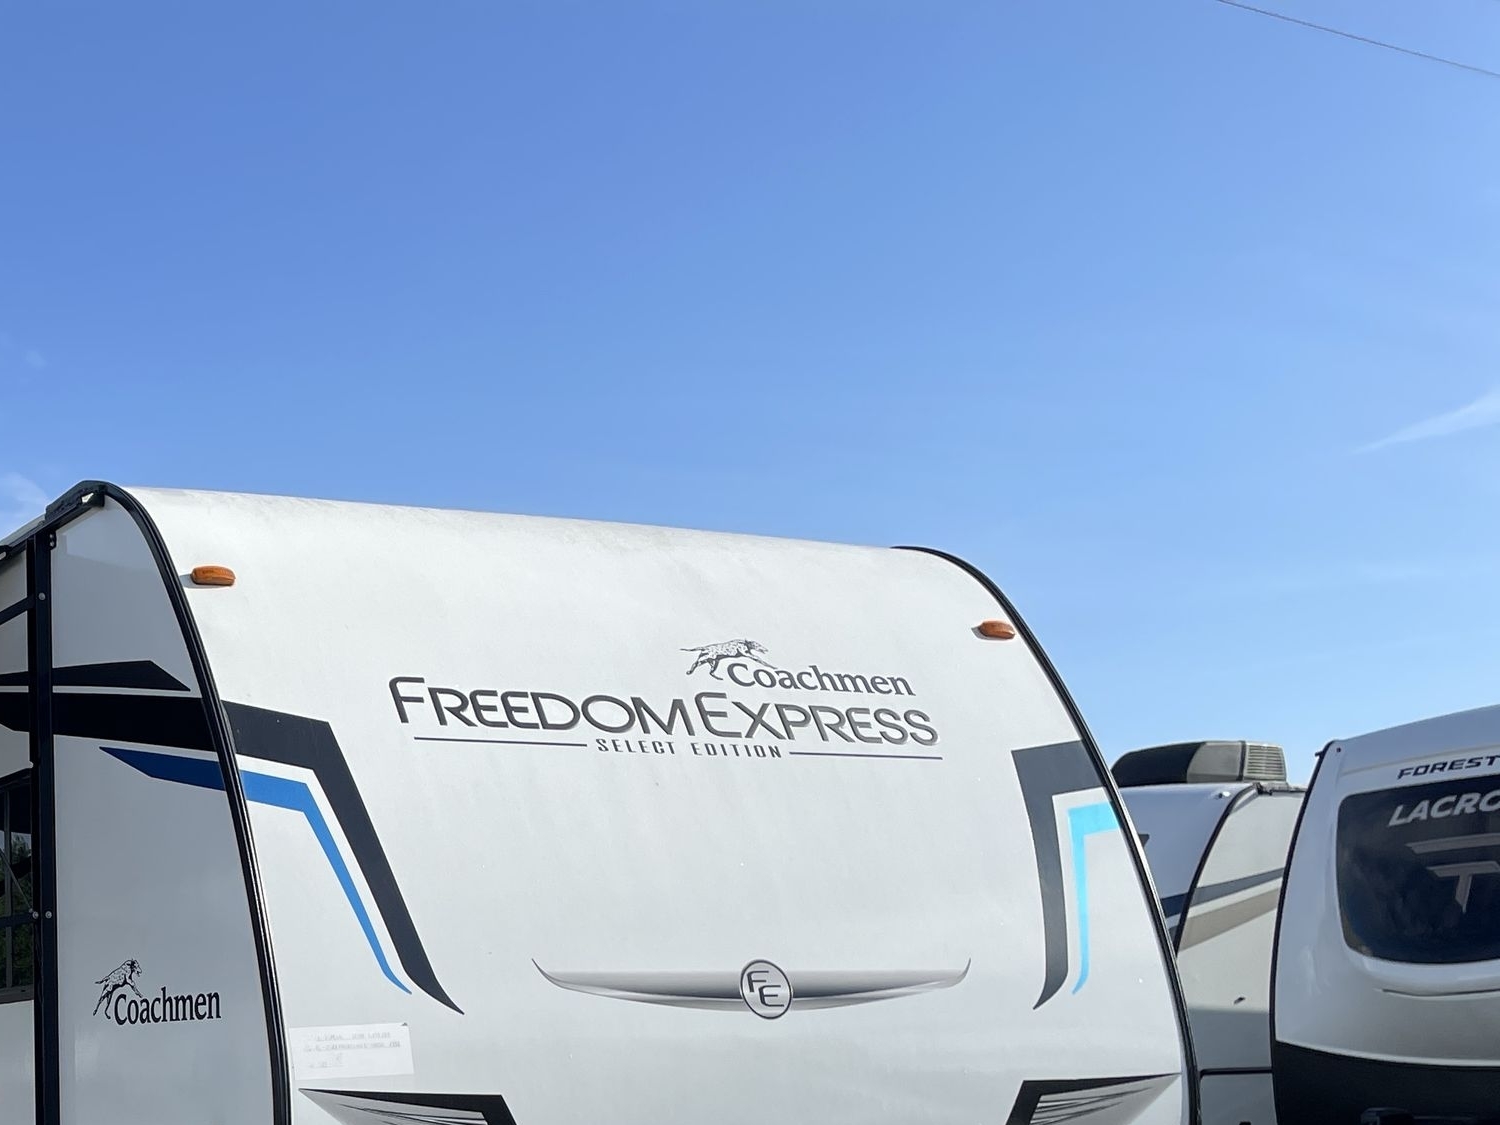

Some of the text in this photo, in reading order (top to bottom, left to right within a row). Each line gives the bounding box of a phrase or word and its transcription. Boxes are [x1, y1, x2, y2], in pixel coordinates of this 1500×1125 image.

[727, 662, 916, 696] Coachmen
[595, 738, 782, 758] SELECT EDITION
[1397, 754, 1500, 780] FOREST
[114, 986, 222, 1026] Coachmen
